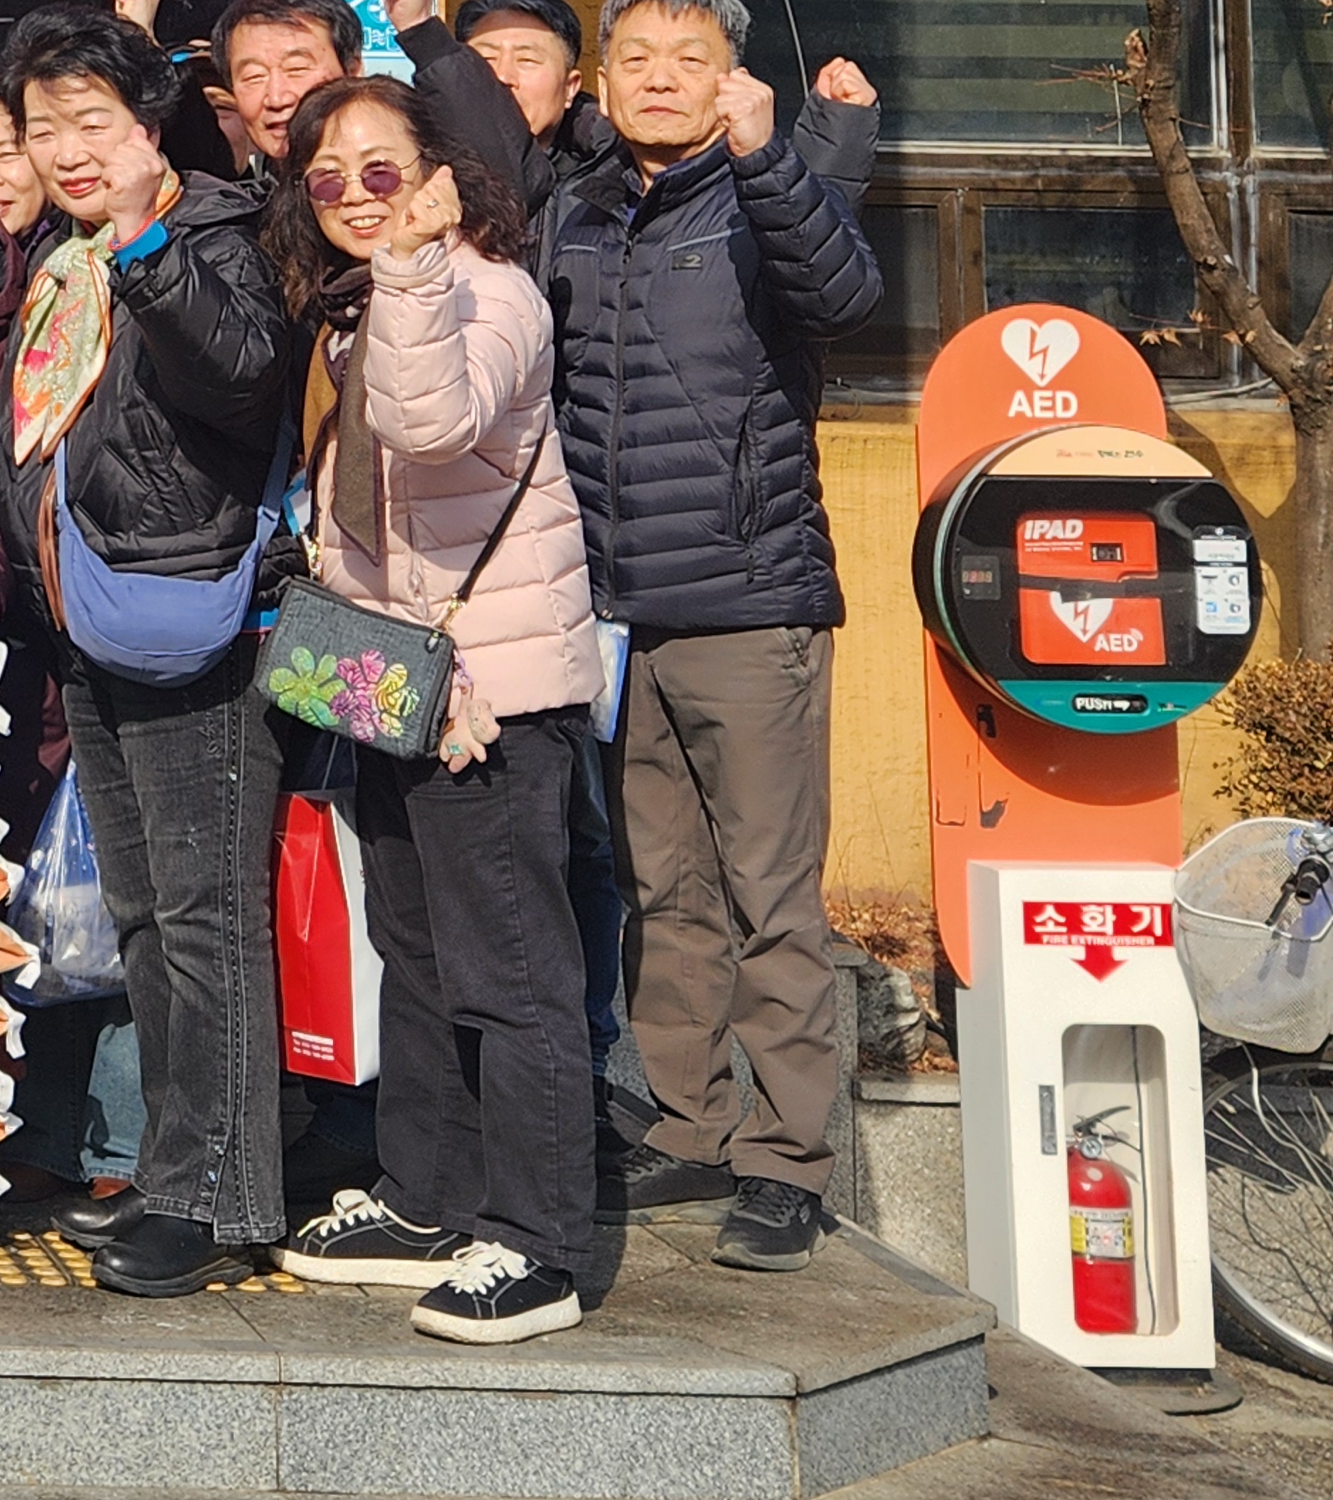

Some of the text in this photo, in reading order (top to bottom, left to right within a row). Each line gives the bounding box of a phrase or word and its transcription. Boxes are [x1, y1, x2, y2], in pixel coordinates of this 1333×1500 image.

[1008, 391, 1078, 418] AED
[1024, 519, 1083, 539] IPAD
[1094, 632, 1138, 652] AED
[1033, 904, 1162, 936] 소화기
[1042, 935, 1155, 946] FIRE EXTINGUISHER
